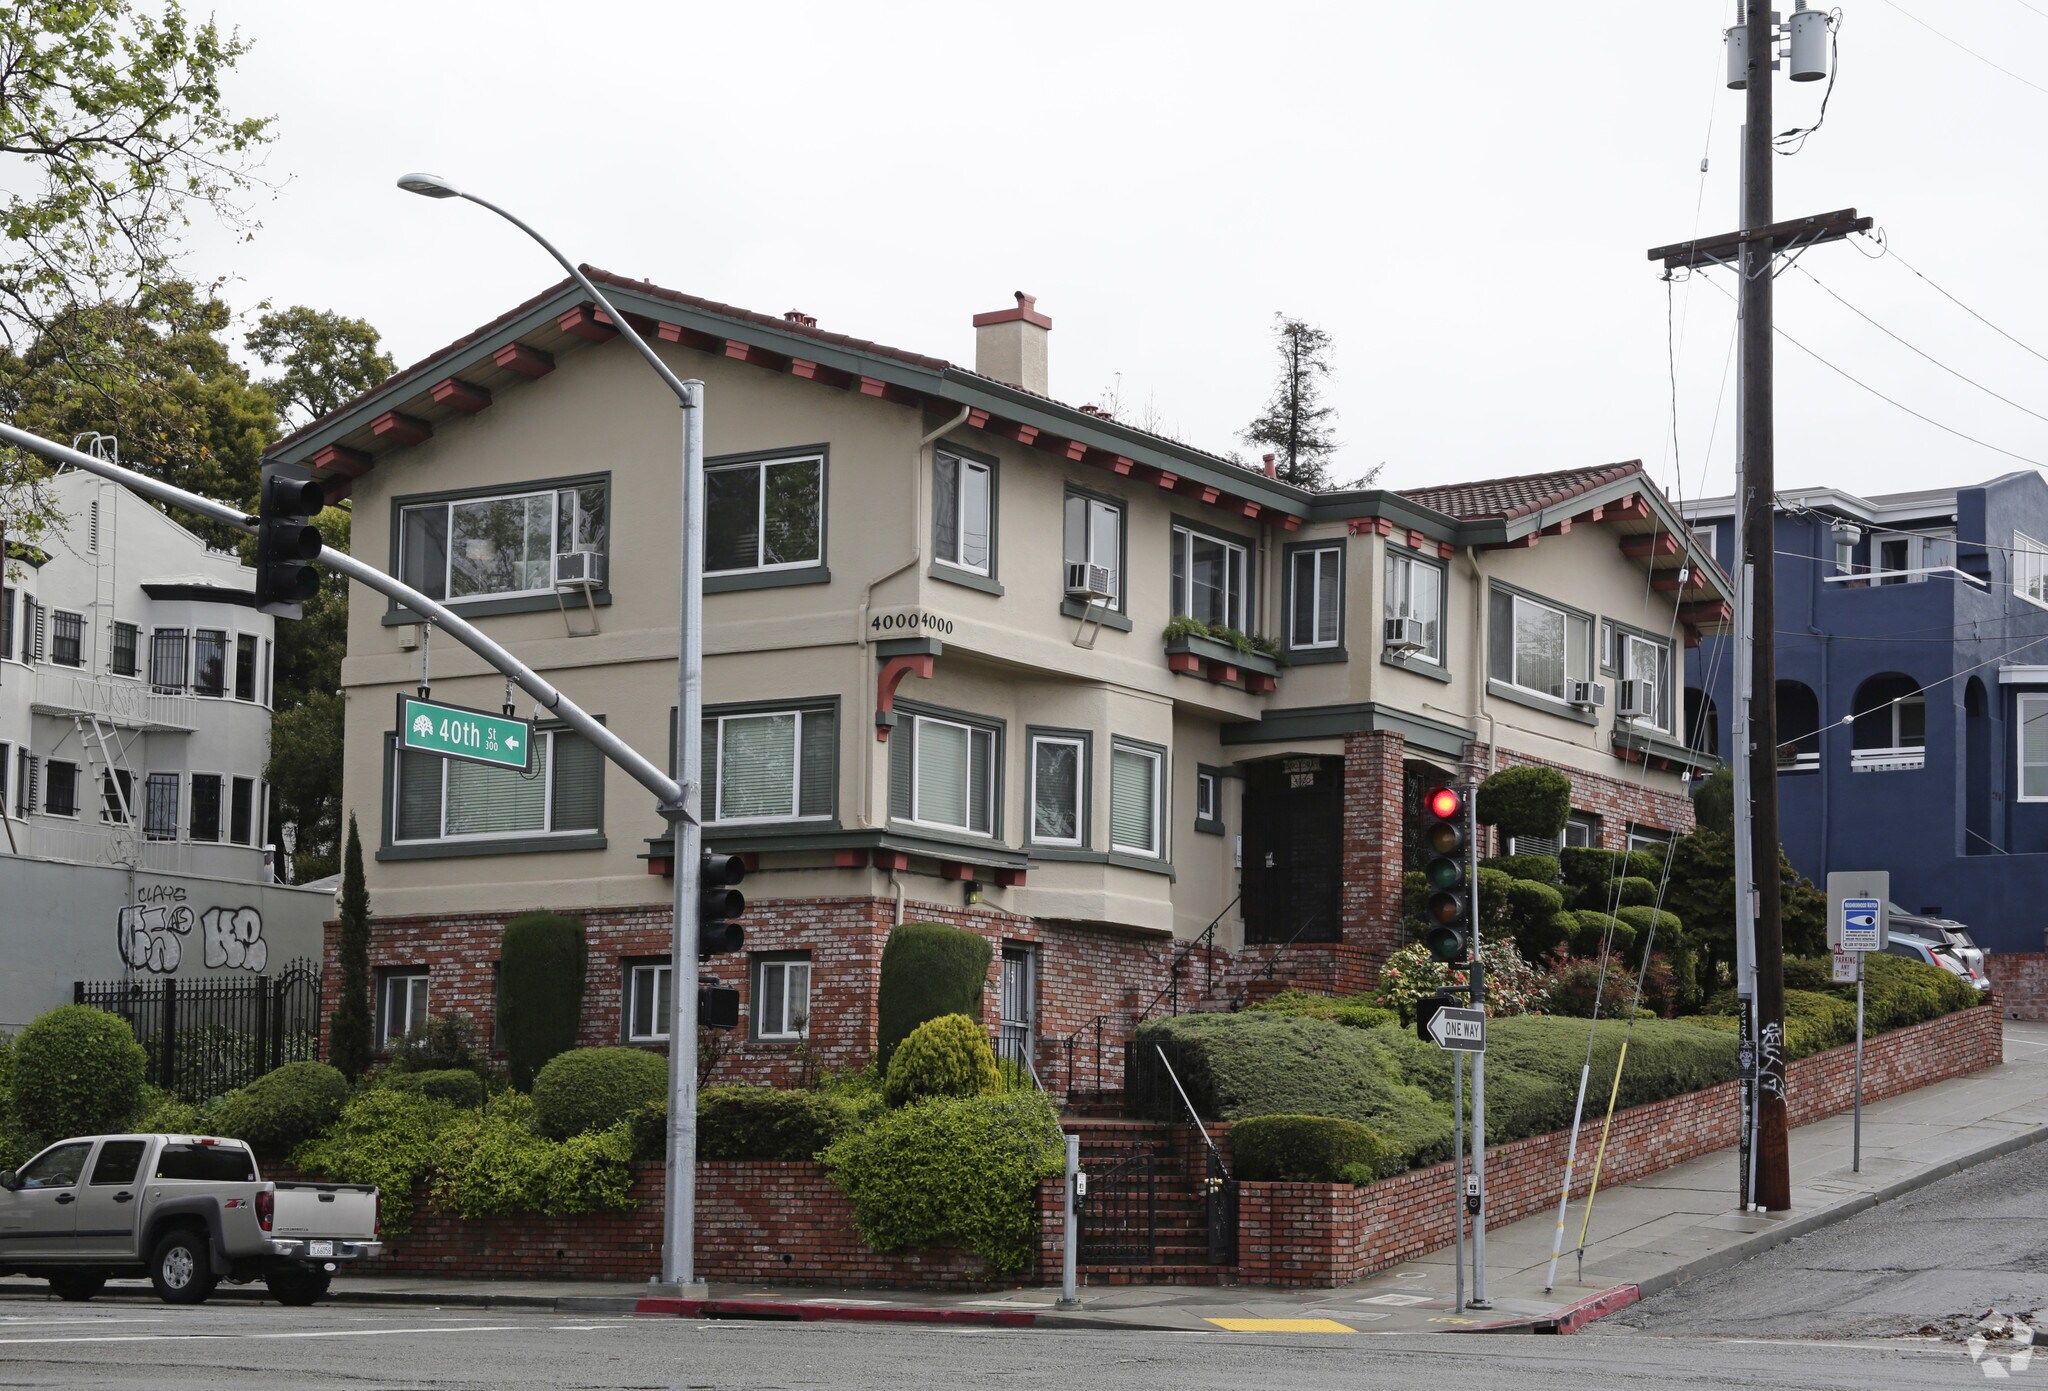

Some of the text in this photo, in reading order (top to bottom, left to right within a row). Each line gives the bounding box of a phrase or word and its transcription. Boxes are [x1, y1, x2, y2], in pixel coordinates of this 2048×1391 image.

[872, 614, 919, 630] 4000
[921, 613, 953, 634] 4000
[440, 719, 496, 748] 40th St
[485, 741, 499, 751] 300
[1835, 956, 1856, 964] PARKING
[1446, 1021, 1479, 1038] ONE WAY
